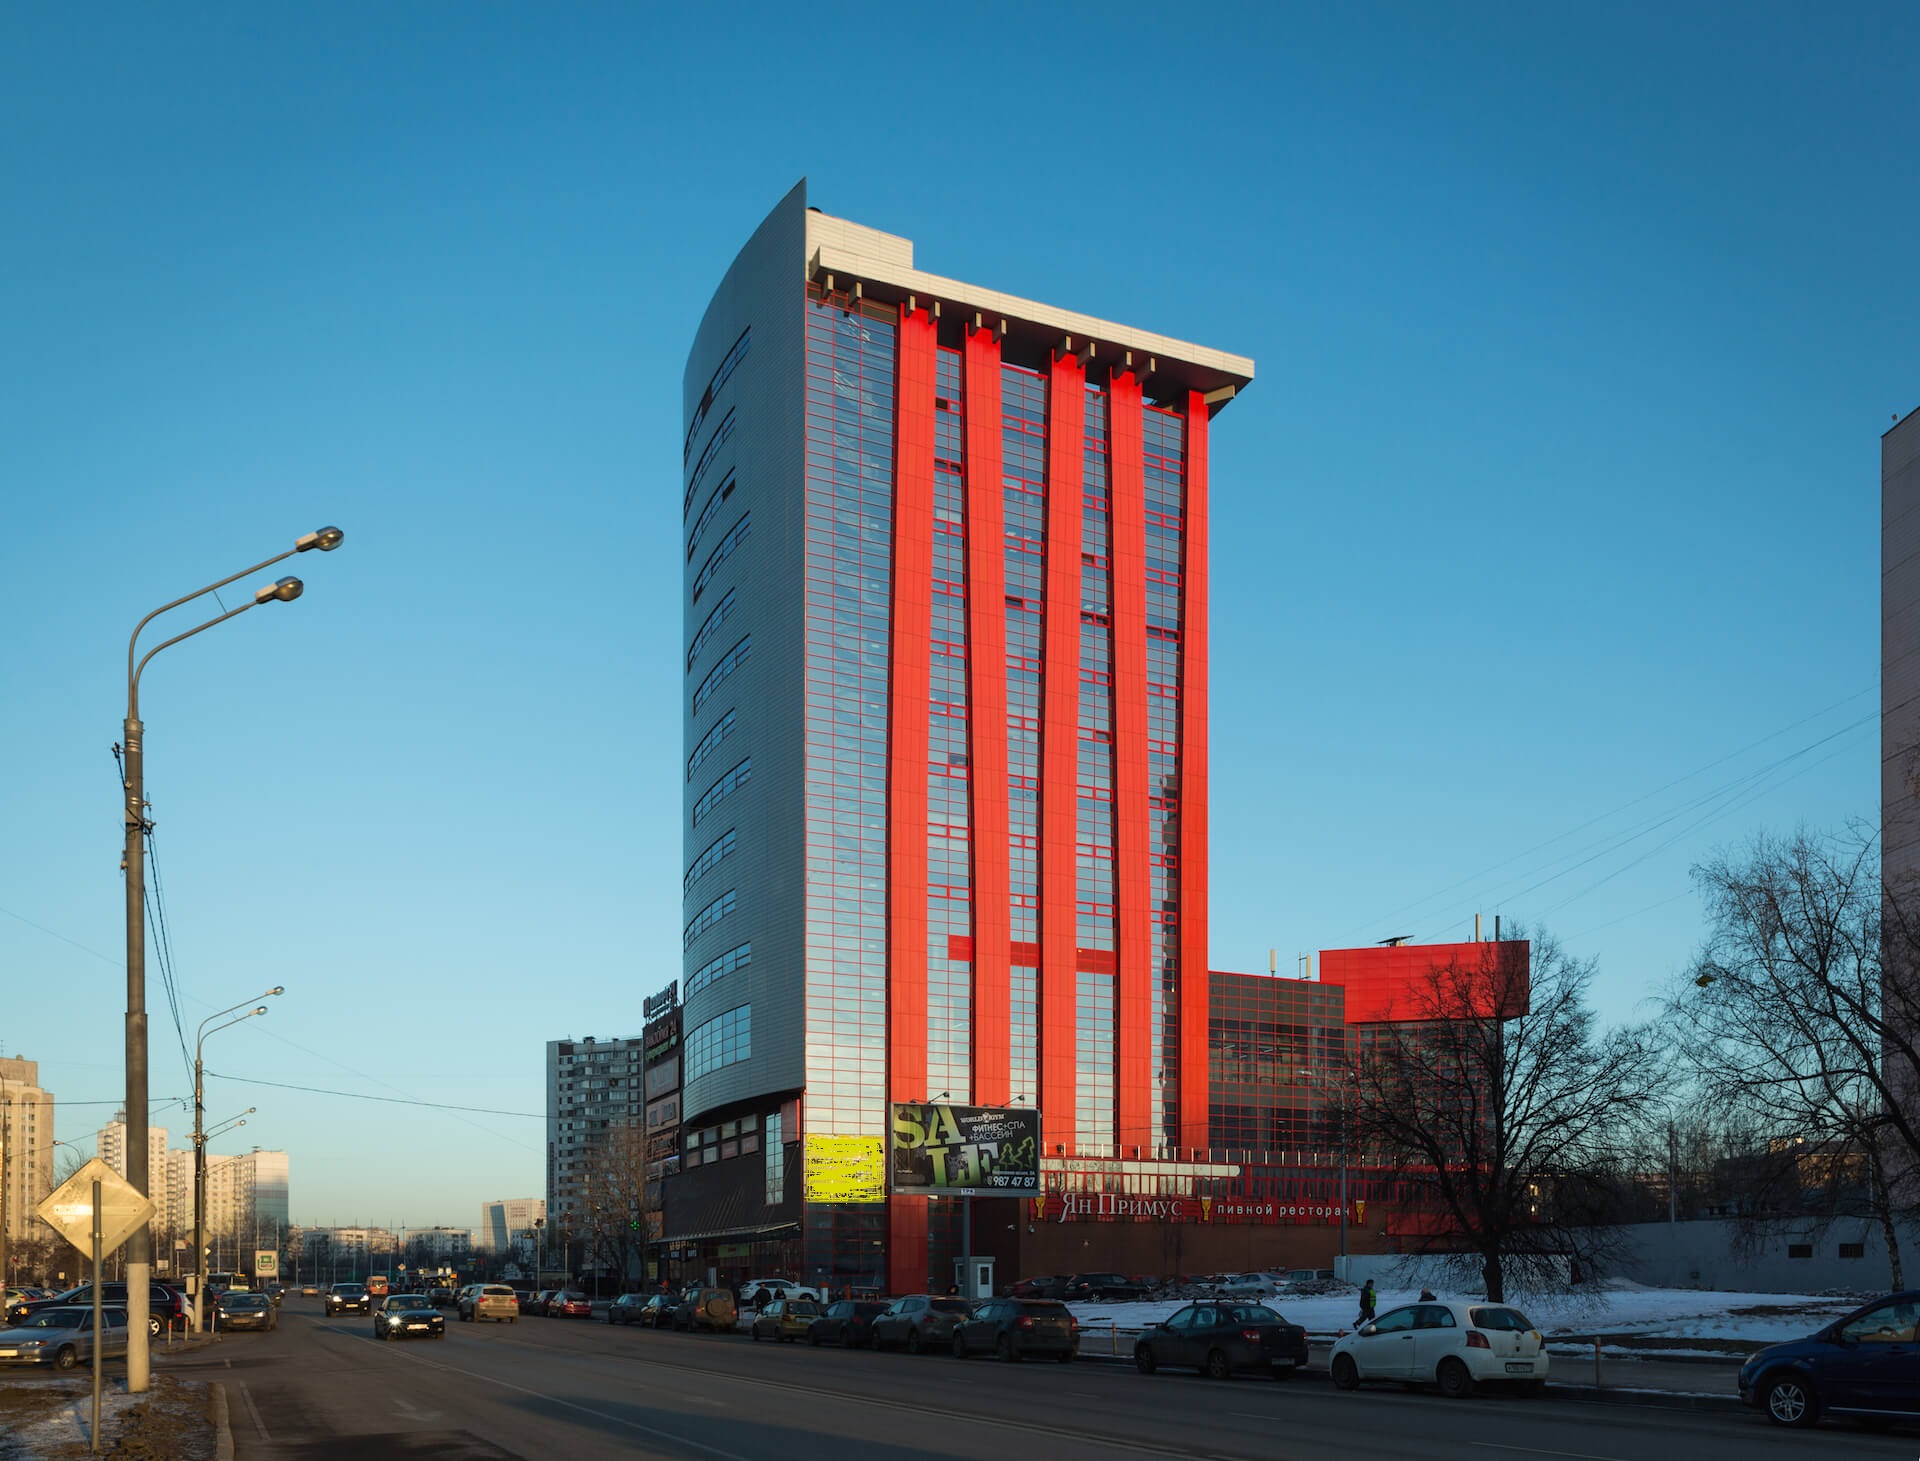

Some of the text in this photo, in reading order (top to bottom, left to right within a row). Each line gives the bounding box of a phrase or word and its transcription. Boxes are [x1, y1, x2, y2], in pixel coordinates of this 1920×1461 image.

[993, 1175, 1010, 1187] 987
[1011, 1176, 1023, 1187] 47
[1023, 1176, 1036, 1188] 87
[1217, 1203, 1273, 1215] пивной
